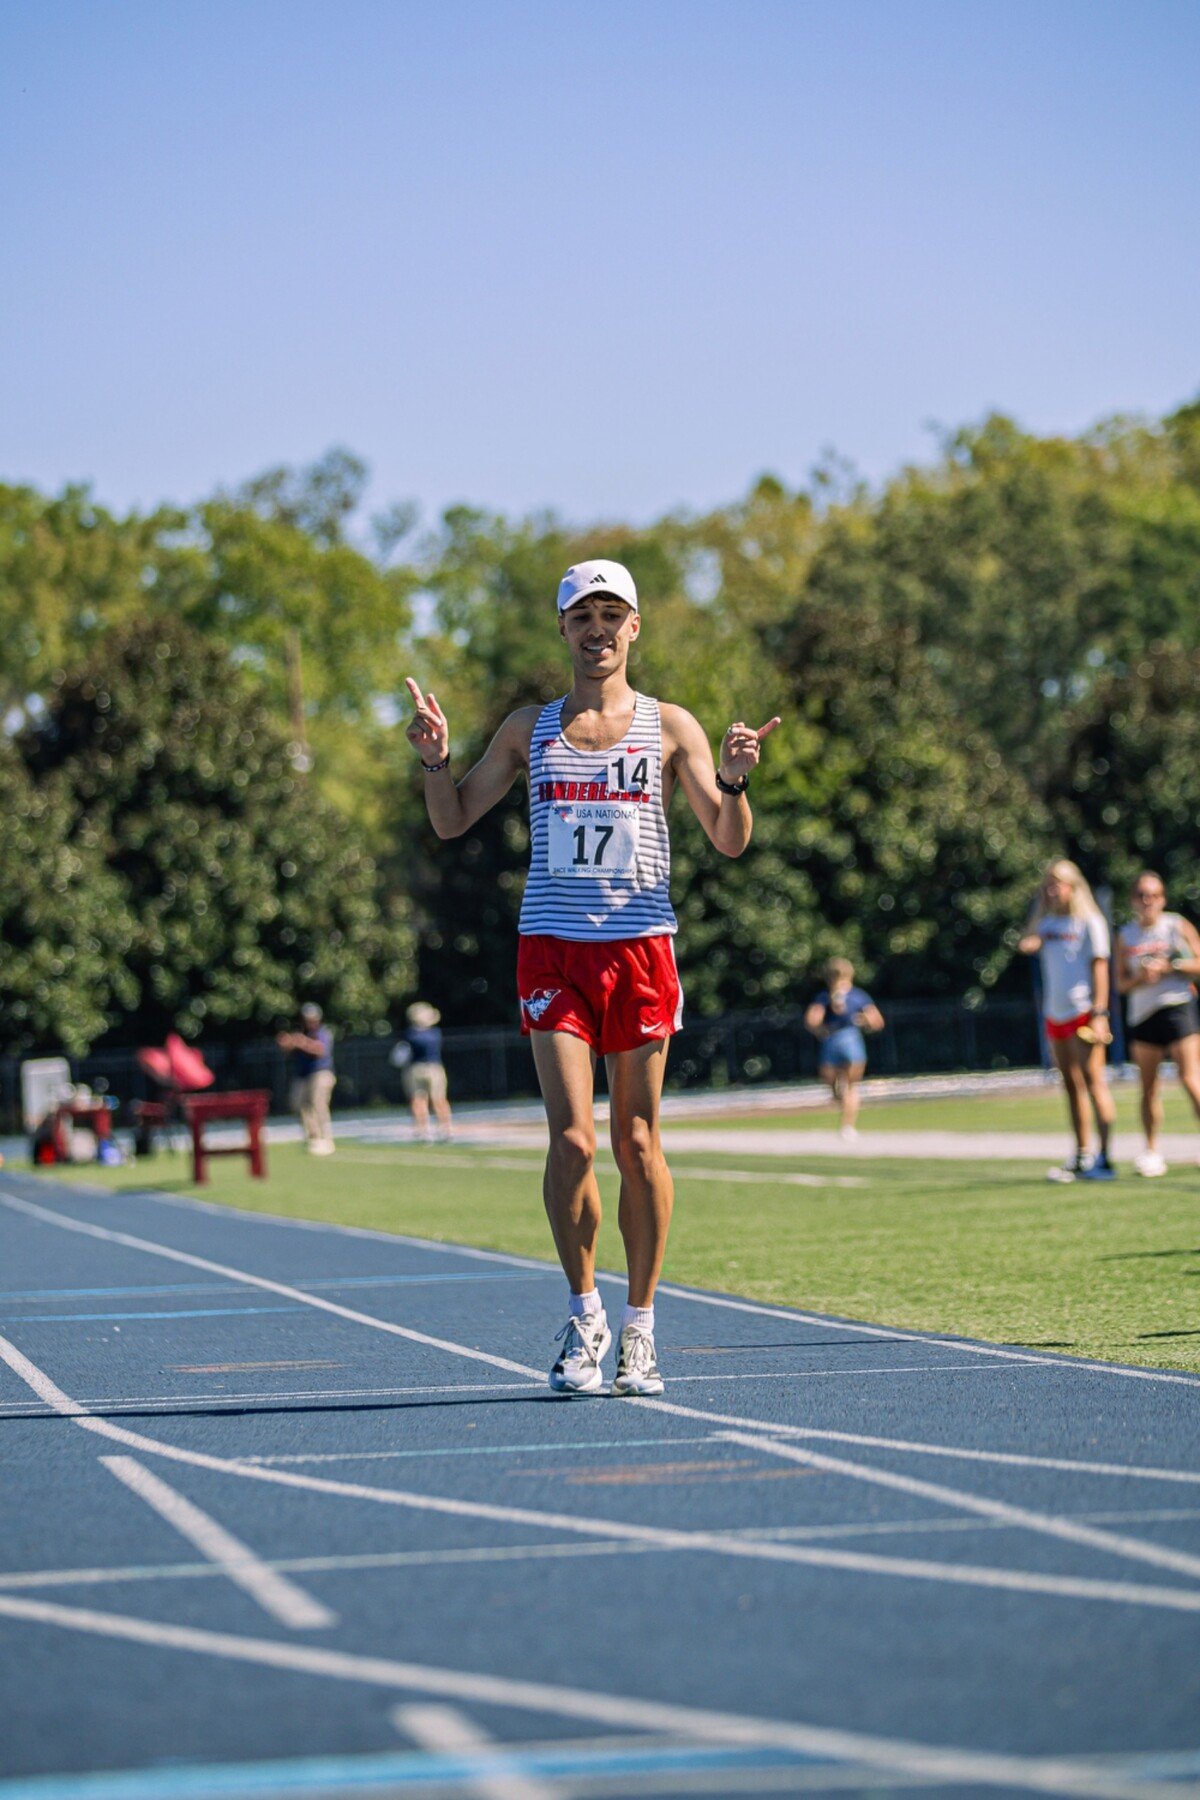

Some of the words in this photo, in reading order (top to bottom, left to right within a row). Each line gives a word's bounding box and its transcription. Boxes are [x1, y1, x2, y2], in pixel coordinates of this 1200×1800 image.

[612, 757, 649, 791] 14
[576, 808, 593, 819] USA
[572, 825, 614, 866] 17
